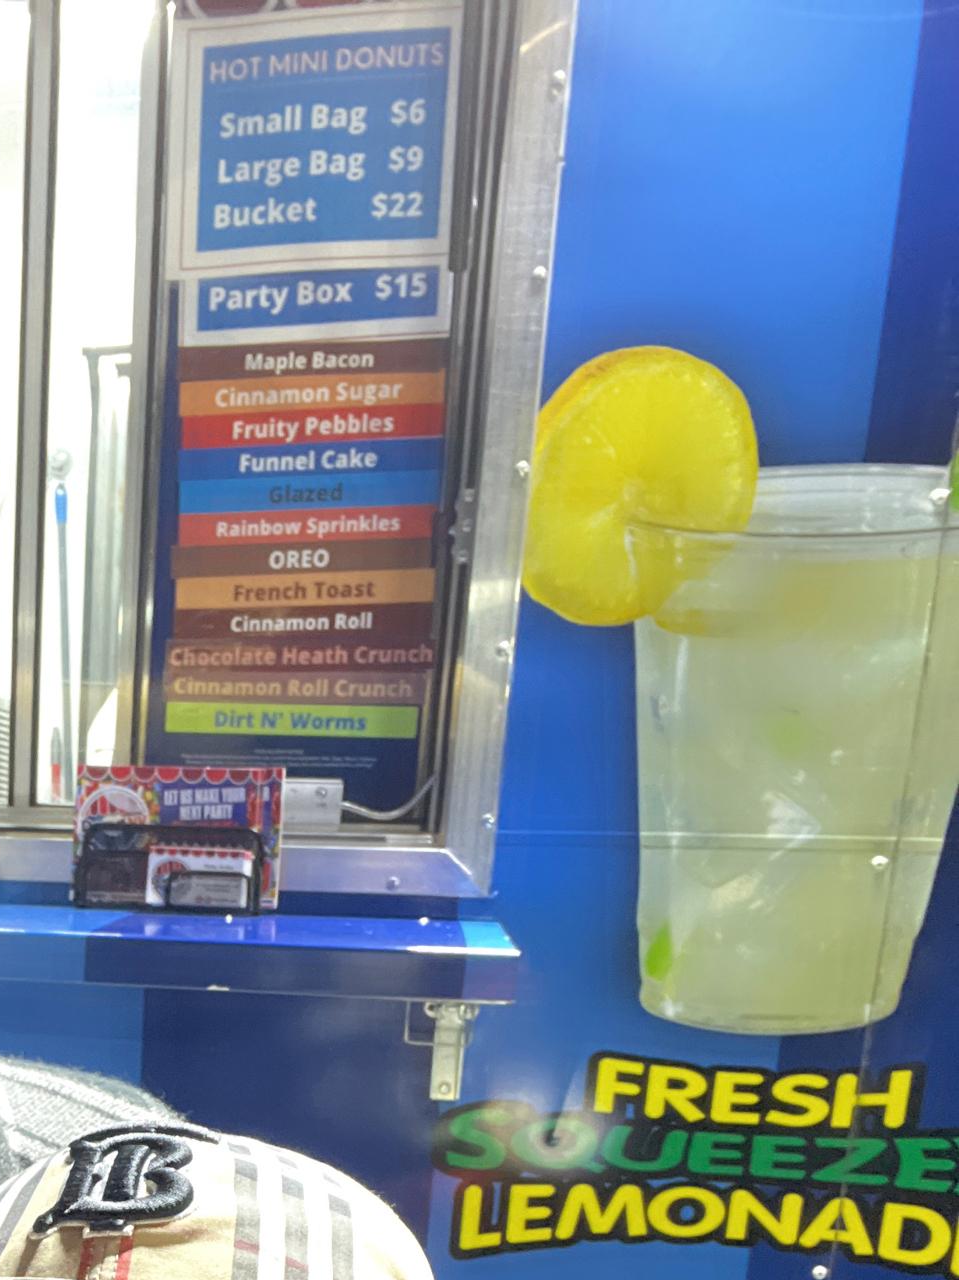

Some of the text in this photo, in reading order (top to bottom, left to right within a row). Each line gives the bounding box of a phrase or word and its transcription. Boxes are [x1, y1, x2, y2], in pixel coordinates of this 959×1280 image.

[208, 43, 444, 84] HOT MINI DONUTS
[220, 98, 426, 138] Small Bag $6
[217, 146, 424, 186] Large Bag $9
[213, 192, 423, 229] Bucket $22
[209, 273, 427, 314] Party Box $15
[245, 351, 374, 375] Maple Bacon
[214, 381, 403, 408] Cinnamon Sugar
[232, 414, 394, 442] Fruity Pebbles
[239, 448, 378, 473] Funnel Cake
[268, 483, 345, 504] Glazed
[216, 515, 401, 538] Rainbow Sprinkles
[268, 549, 330, 569] OREO
[233, 580, 376, 602] French Toast
[230, 612, 373, 633] Cinnamon Roll
[169, 643, 433, 667] Chocolate Heath Crunch
[173, 677, 413, 698] Cinnamon Roll Crunch
[214, 710, 367, 731] Dirt N' Worms
[593, 1056, 913, 1130] FRESH
[445, 1108, 959, 1194] SQUEEZE
[458, 1181, 959, 1277] LEMONAD
